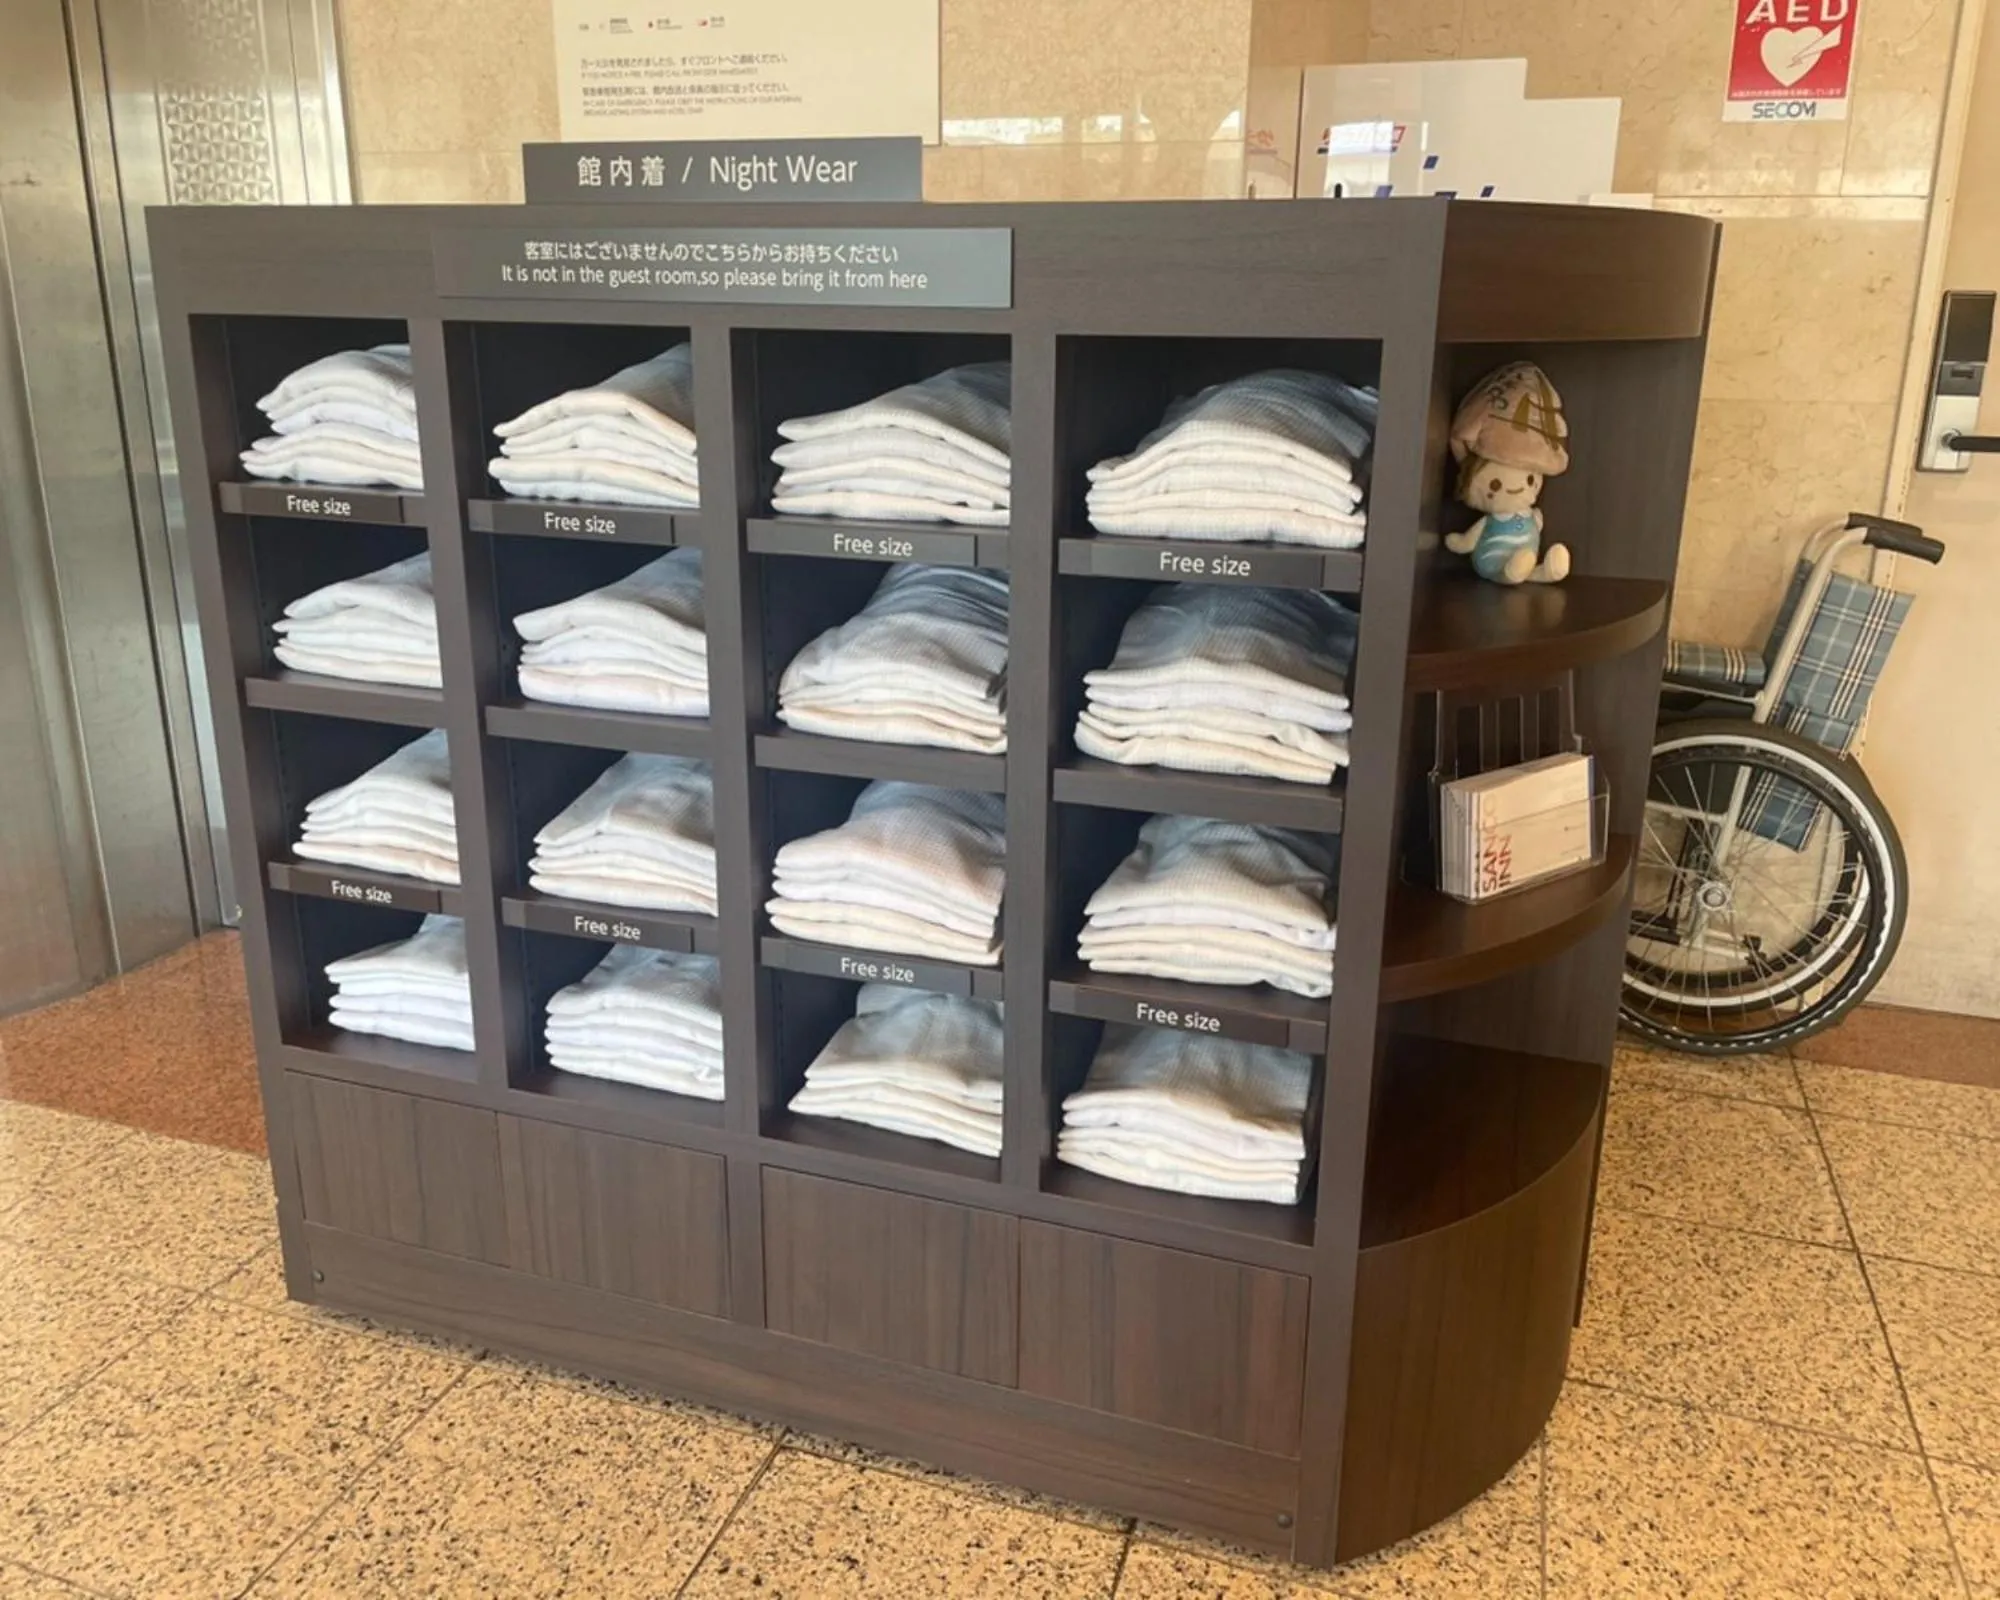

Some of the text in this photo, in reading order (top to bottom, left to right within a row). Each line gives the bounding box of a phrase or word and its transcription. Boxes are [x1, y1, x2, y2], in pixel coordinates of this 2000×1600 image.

[1745, 0, 1849, 24] AED
[1752, 101, 1817, 119] SECOM
[577, 155, 666, 187] 館内着
[709, 154, 779, 192] Night
[785, 153, 859, 184] Wear
[524, 240, 900, 266] 客室にはございませんのでこちらからお持ちください
[502, 265, 513, 283] It
[517, 265, 529, 283] is
[533, 266, 557, 283] not
[562, 266, 576, 283] in
[580, 266, 605, 284] the
[609, 266, 651, 288] guest
[724, 268, 777, 291] please
[781, 268, 825, 293] bring
[829, 269, 840, 288] it
[845, 268, 885, 289] from
[889, 269, 929, 290] here
[286, 494, 351, 516] Free size
[544, 511, 616, 533] Free size
[833, 533, 913, 556] Free size
[1159, 551, 1252, 577] Free size
[1499, 834, 1512, 888] INN
[331, 879, 392, 903] Free size
[574, 915, 640, 941] Free size
[840, 956, 914, 982] Free size
[1136, 1002, 1220, 1031] Free size
